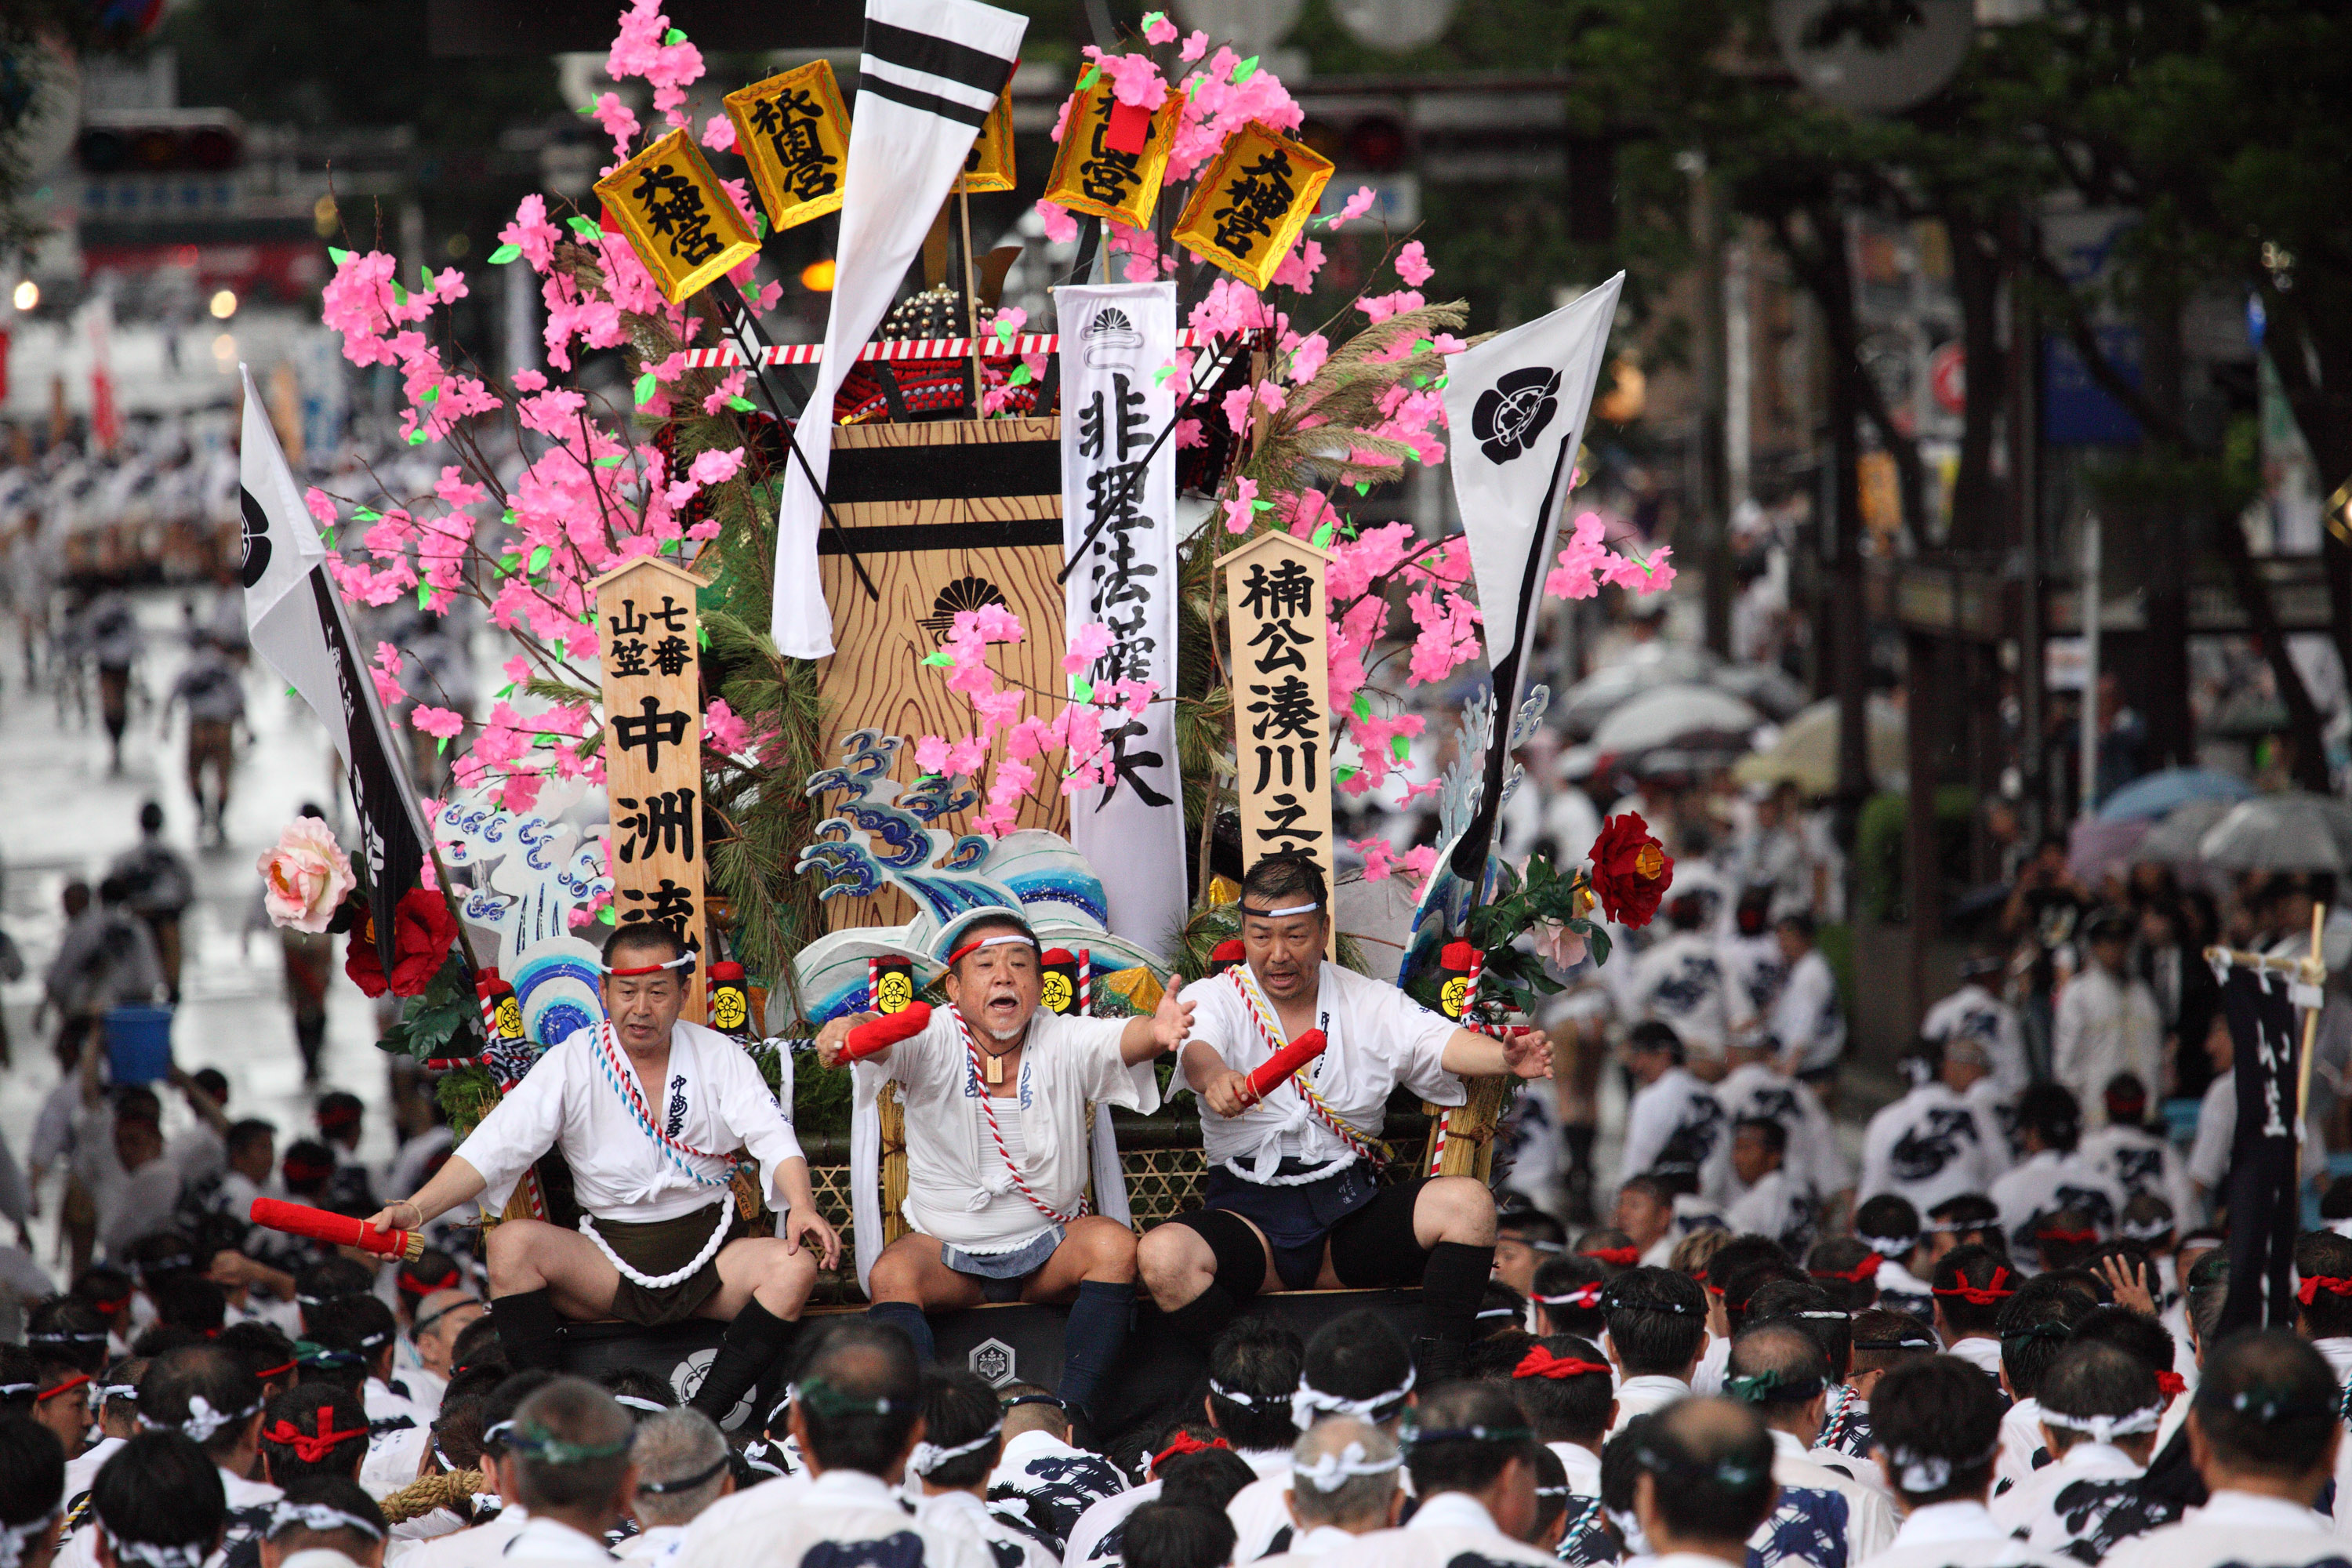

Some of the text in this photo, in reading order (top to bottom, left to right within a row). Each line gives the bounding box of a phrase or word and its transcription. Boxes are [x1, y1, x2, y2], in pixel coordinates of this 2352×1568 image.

[608, 600, 650, 679] 山笠
[650, 596, 693, 677] 七番
[610, 695, 702, 953] 中洲流
